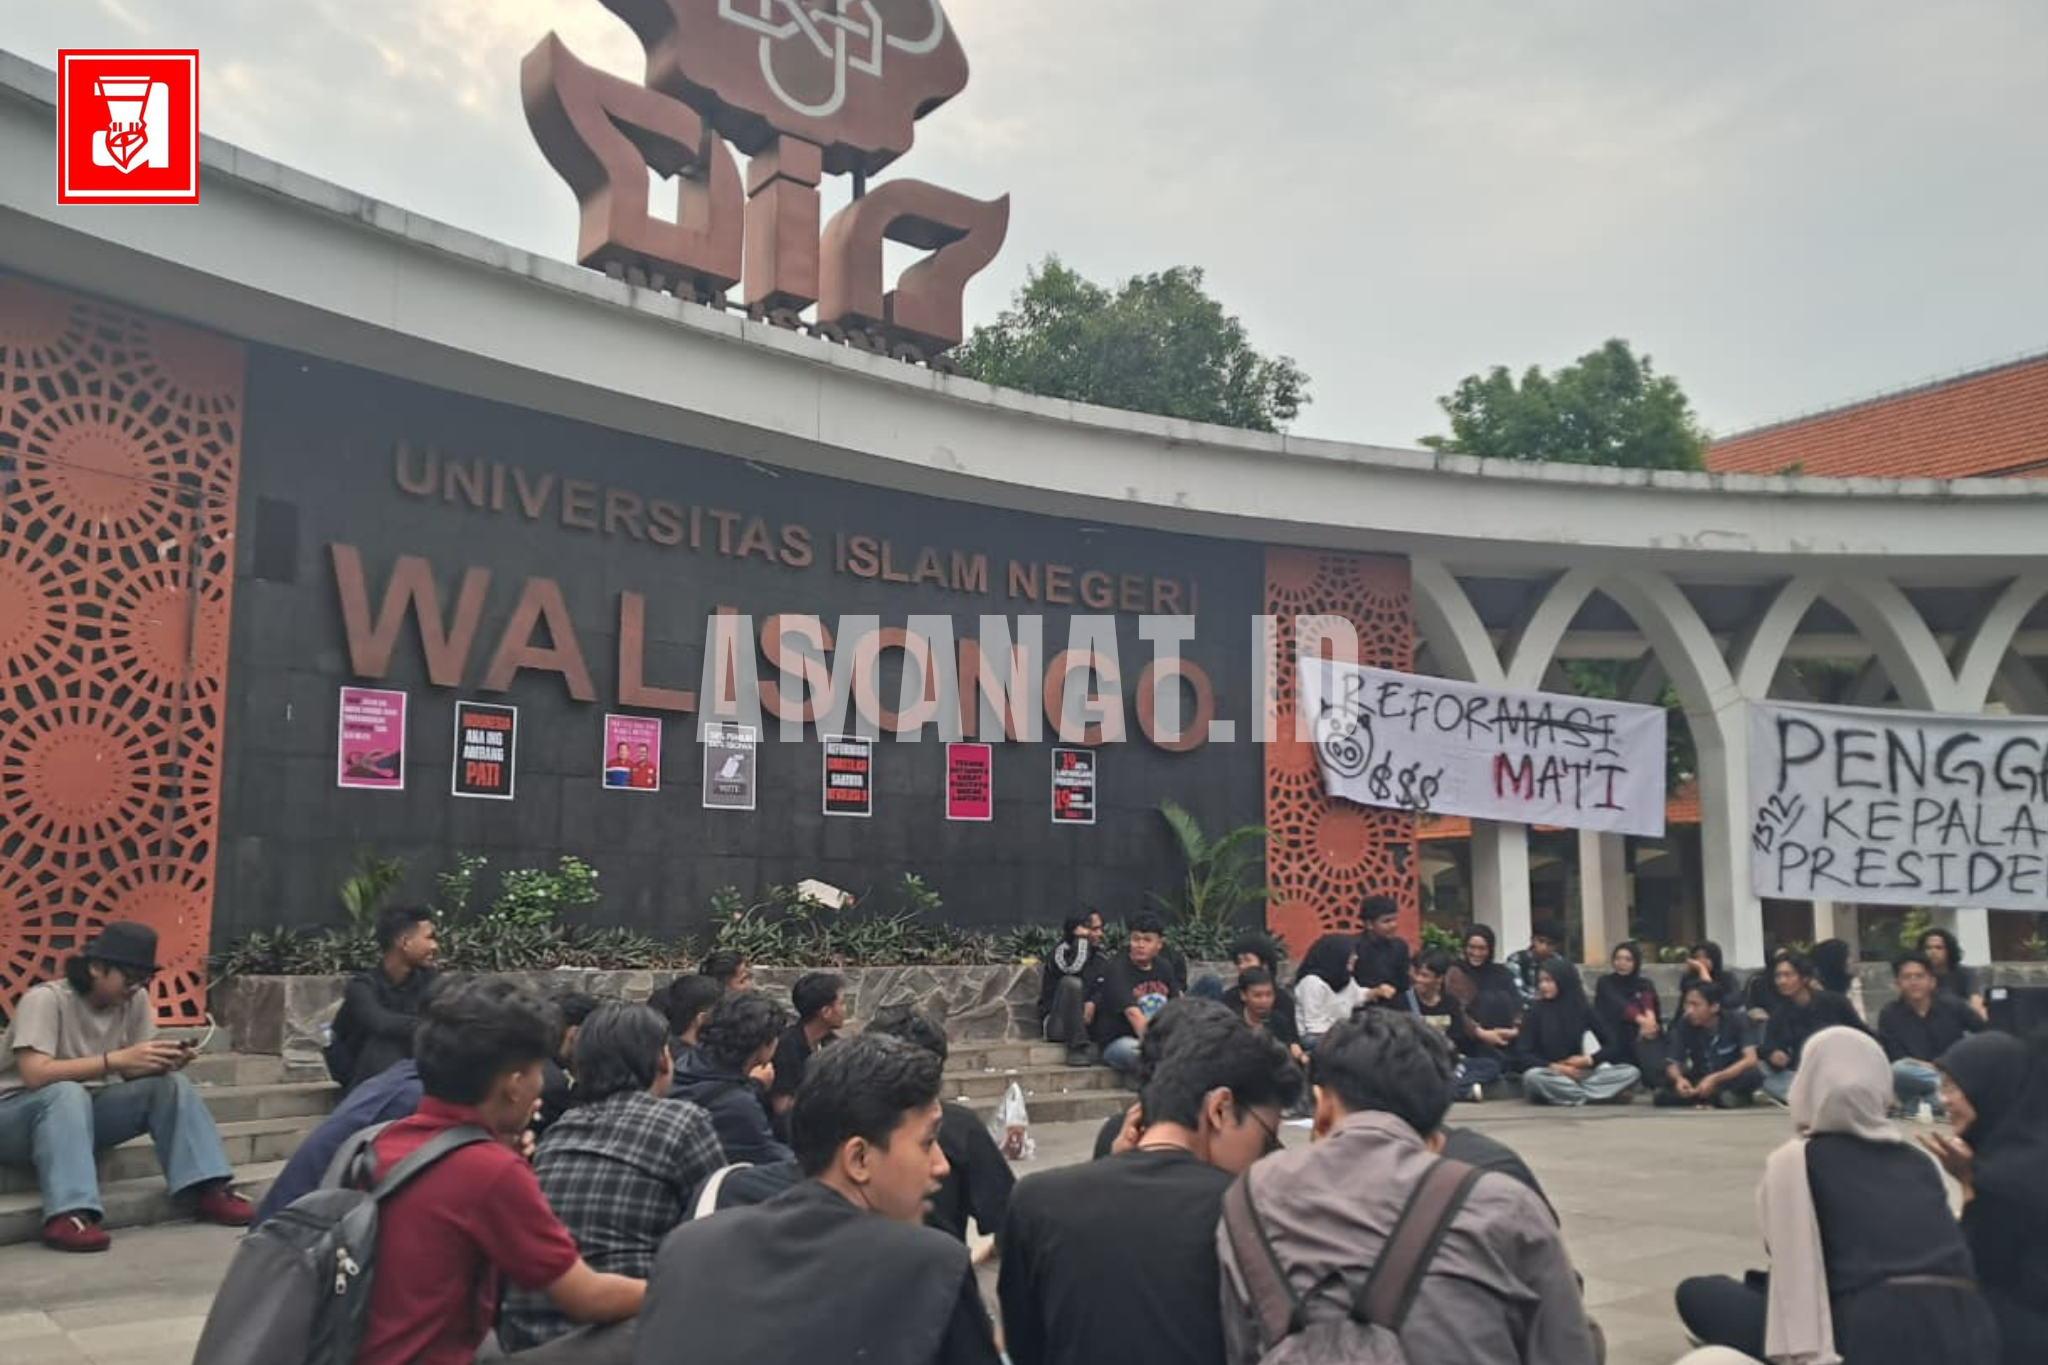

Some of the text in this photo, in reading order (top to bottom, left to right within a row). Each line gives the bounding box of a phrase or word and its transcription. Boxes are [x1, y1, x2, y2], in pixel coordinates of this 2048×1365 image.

[394, 440, 1199, 616] UNIVERSITAS ISLAM NEGERI
[328, 541, 1216, 752] WALISONGO
[1342, 673, 1620, 757] REFORMASI
[465, 761, 500, 787] PATI
[1492, 752, 1628, 812] MATI
[1822, 796, 2048, 849] KEPALA
[1777, 841, 2048, 895] PRESIDE
